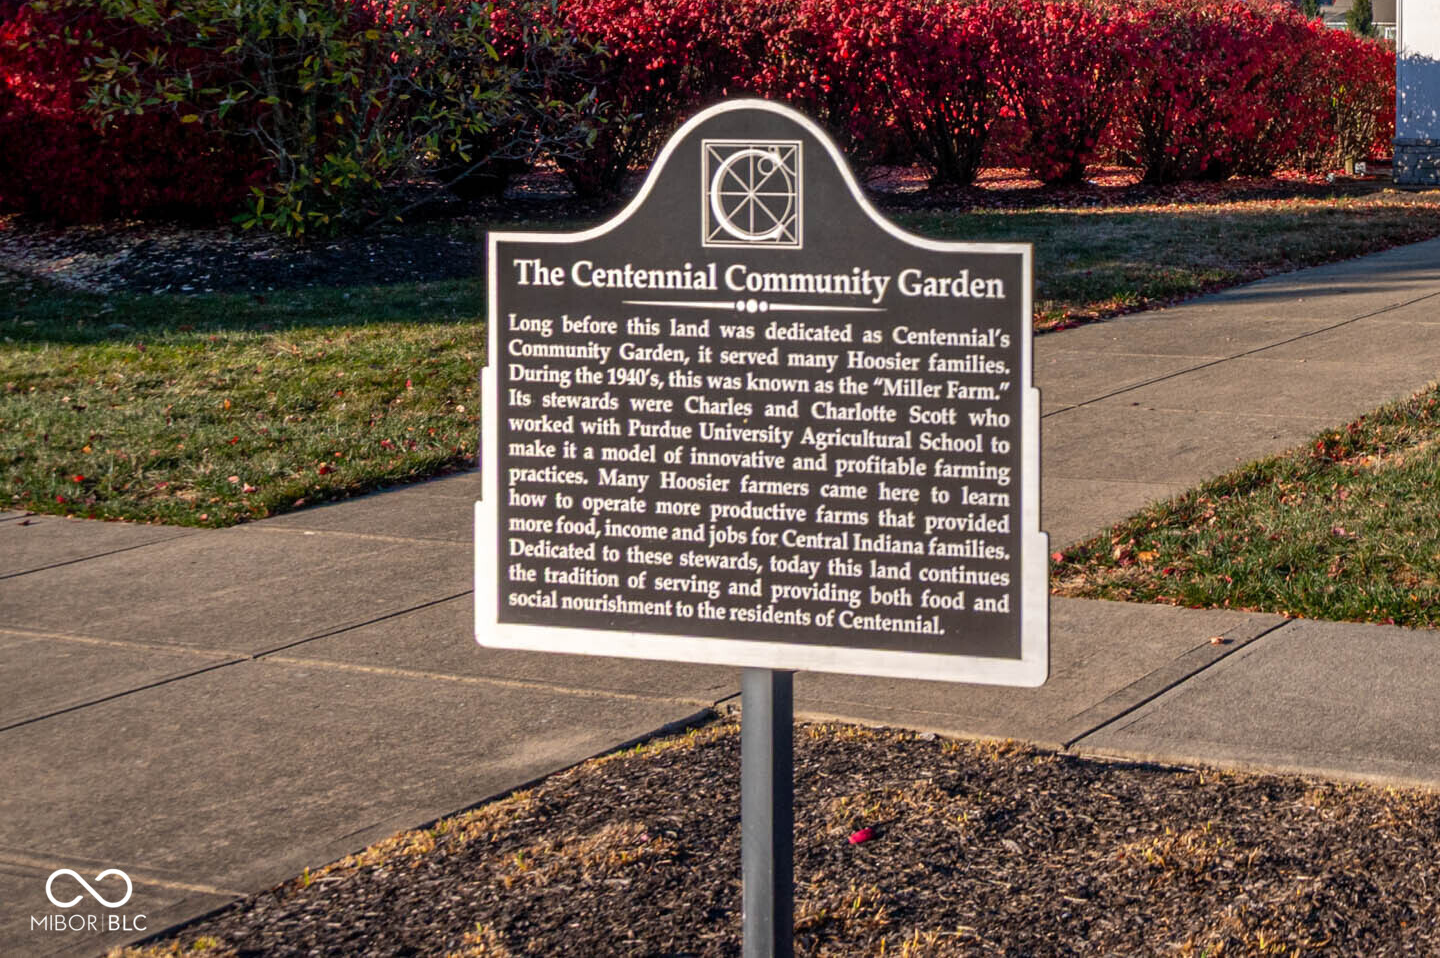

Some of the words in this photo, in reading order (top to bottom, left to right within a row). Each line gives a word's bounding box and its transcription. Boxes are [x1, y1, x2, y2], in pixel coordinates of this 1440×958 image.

[513, 258, 565, 286] The
[571, 260, 718, 291] Centennial
[724, 264, 891, 304] Community
[897, 268, 1005, 299] Garden
[508, 313, 553, 338] Long
[562, 314, 618, 335] before
[627, 316, 661, 336] this
[669, 318, 710, 338] land
[719, 325, 755, 339] was
[764, 321, 853, 343] dedicated
[862, 330, 883, 344] as
[892, 326, 1010, 348] Centennial's
[508, 338, 612, 365] Community
[619, 342, 690, 366] Garden,
[698, 345, 713, 363] it
[720, 347, 779, 366] served
[787, 353, 839, 374] many
[847, 350, 921, 371] Hoosier
[928, 352, 1010, 375] families.
[508, 363, 572, 389] During
[575, 365, 604, 385] the
[607, 367, 665, 390] 1940's,
[668, 369, 703, 388] this
[706, 375, 742, 390] was
[746, 372, 810, 393] known
[814, 380, 834, 394] as
[838, 376, 869, 395] the
[508, 388, 532, 407] Its
[542, 391, 619, 411] stewards
[629, 398, 673, 413] were
[684, 395, 753, 416] Charles
[764, 399, 799, 418] and
[811, 401, 897, 423] Charlotte
[909, 405, 957, 425] Scott
[968, 407, 1010, 428] who
[508, 414, 575, 434] worked
[580, 417, 621, 436] with
[627, 418, 693, 439] Purdue
[699, 421, 794, 449] University
[799, 426, 912, 451] Agricultural
[919, 432, 983, 453] School
[991, 436, 1011, 454] to
[508, 439, 556, 458] make
[563, 440, 577, 459] it
[583, 446, 594, 460] a
[601, 443, 656, 463] model
[663, 445, 684, 464] of
[690, 446, 785, 469] innovative
[792, 452, 827, 471] and
[835, 454, 927, 478] profitable
[934, 458, 1011, 486] farming
[508, 465, 589, 487] practices.
[598, 467, 650, 493] Many
[660, 471, 731, 492] Hoosier
[740, 474, 810, 496] farmers
[820, 484, 868, 500] came
[878, 481, 920, 502] here
[931, 486, 950, 504] to
[961, 485, 1010, 507] learn
[508, 487, 547, 507] how
[555, 492, 573, 509] to
[582, 496, 647, 516] operate
[655, 501, 701, 516] more
[710, 500, 807, 523] productive
[815, 504, 869, 526] farms
[878, 508, 916, 528] that
[924, 512, 1010, 535] provided
[508, 517, 553, 533] more
[555, 515, 602, 539] food,
[604, 518, 668, 540] income
[671, 523, 706, 542] and
[708, 524, 748, 548] jobs
[751, 526, 779, 546] for
[781, 529, 849, 550] Central
[853, 533, 924, 555] Indiana
[928, 536, 1010, 560] families.
[508, 537, 596, 561] Dedicated
[602, 545, 620, 562] to
[626, 545, 673, 566] these
[679, 550, 763, 574] stewards,
[769, 554, 821, 580] today
[828, 557, 863, 577] this
[870, 559, 911, 581] land
[918, 565, 1010, 586] continues
[508, 562, 537, 582] the
[544, 566, 620, 588] tradition
[627, 570, 647, 589] of
[654, 574, 721, 600] serving
[728, 578, 763, 597] and
[770, 582, 862, 609] providing
[870, 585, 913, 607] both
[921, 588, 965, 610] food
[973, 593, 1010, 613] and
[508, 589, 558, 609] social
[561, 593, 673, 617] nourishment
[675, 600, 694, 618] to
[697, 600, 726, 620] the
[729, 604, 812, 626] residents
[815, 608, 836, 627] of
[838, 610, 945, 635] Centennial.
